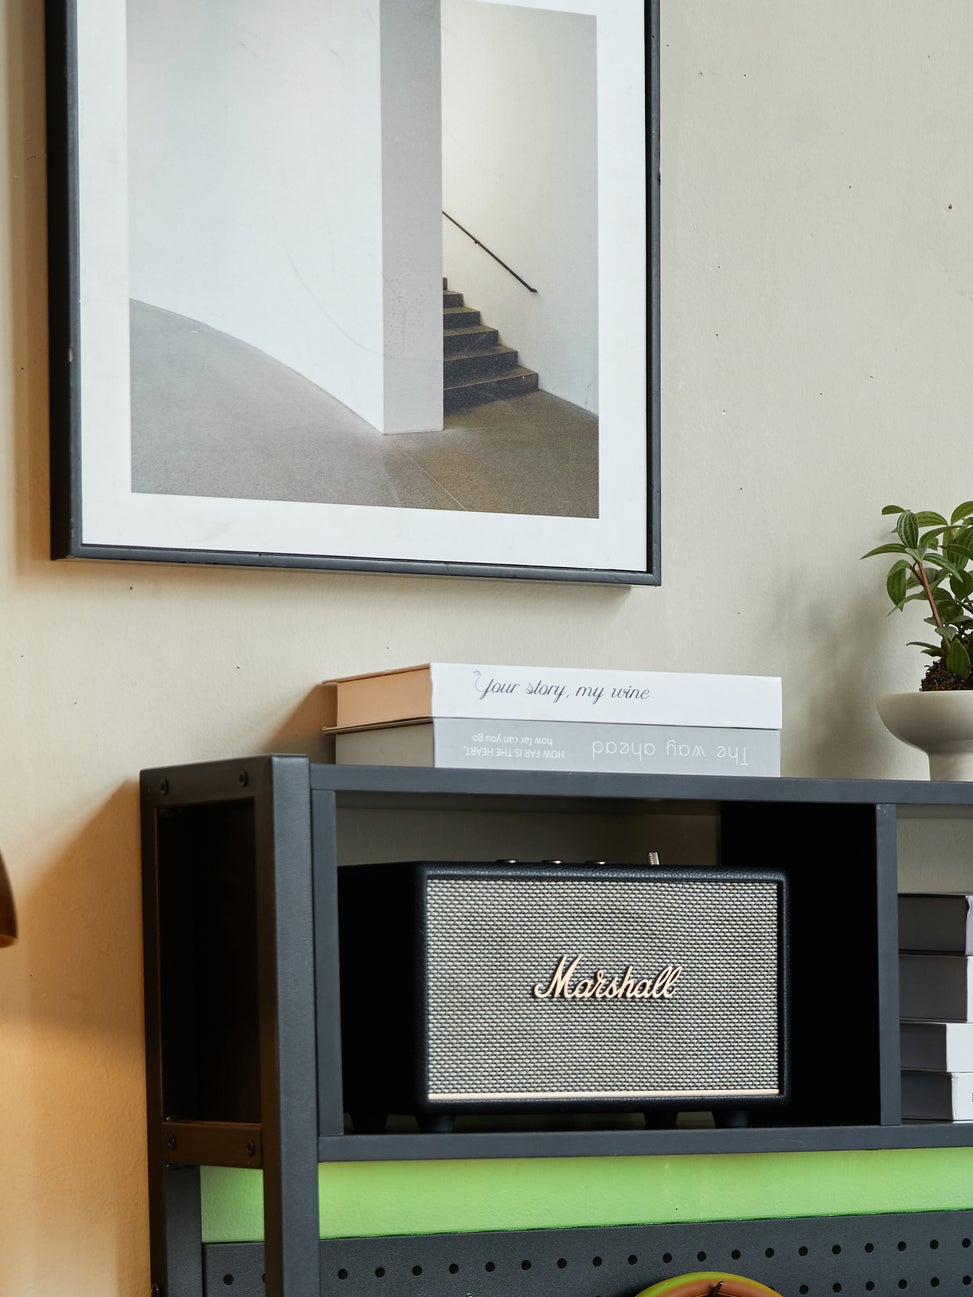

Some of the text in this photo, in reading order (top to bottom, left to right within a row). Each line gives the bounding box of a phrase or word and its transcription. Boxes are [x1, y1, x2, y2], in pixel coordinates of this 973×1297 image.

[525, 680, 570, 703] story,
[575, 685, 605, 704] my
[611, 685, 651, 700] wine
[472, 732, 553, 746] how far can you go
[495, 747, 513, 757] THE
[525, 749, 540, 759] FAR
[542, 749, 565, 759] HOW
[592, 739, 749, 766] The way ahead
[533, 955, 683, 999] Marshall
